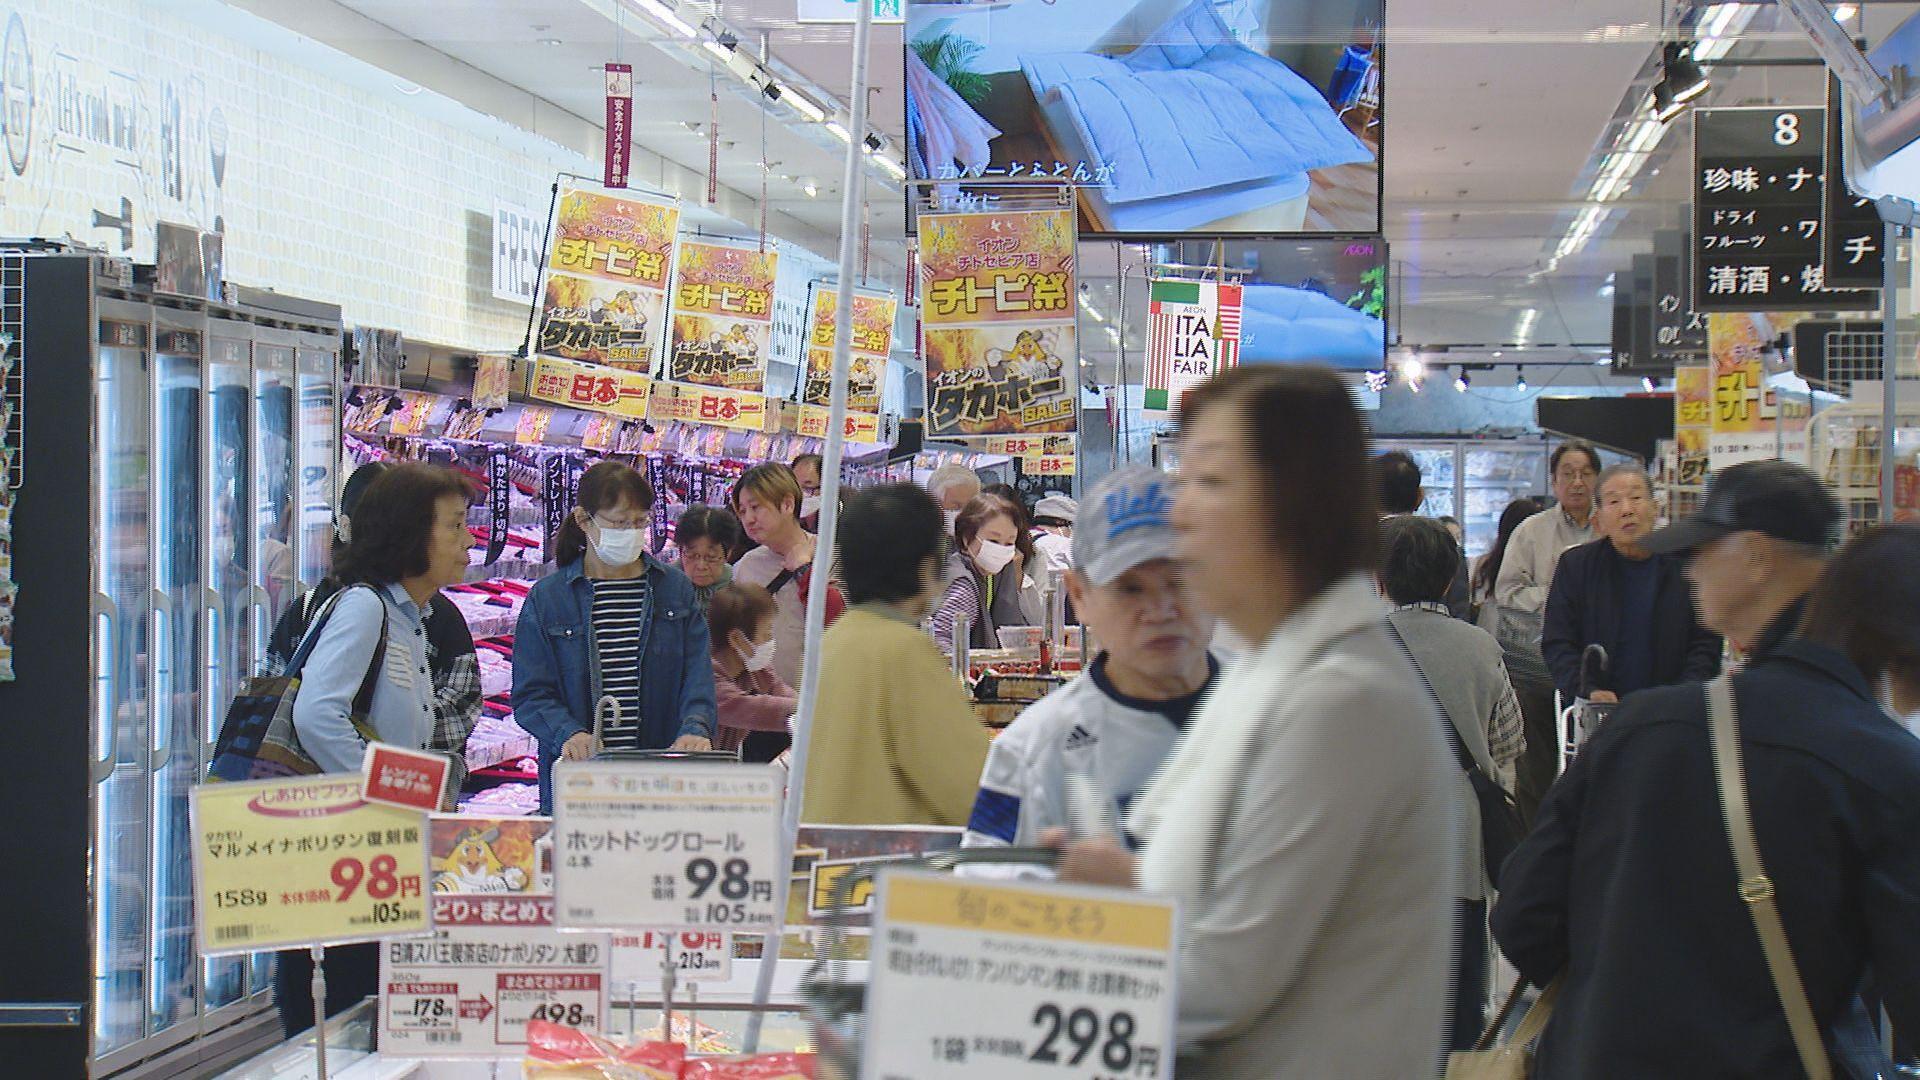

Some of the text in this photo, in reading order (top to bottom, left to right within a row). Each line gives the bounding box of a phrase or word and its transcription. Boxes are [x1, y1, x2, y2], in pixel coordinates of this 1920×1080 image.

[1774, 113, 1799, 145] 8
[936, 161, 1118, 182] カバーとふとんが
[1703, 167, 1824, 193] 珍味・ナ
[1713, 210, 1757, 225] ドライ
[979, 237, 1019, 252] イオン
[1703, 235, 1766, 250] フルーツ
[558, 237, 665, 281] チトピ祭
[681, 283, 768, 316] チトピ祭
[930, 271, 1068, 314] チトピ祭
[541, 318, 646, 351] タカホー
[815, 323, 889, 353] チピ祭
[1175, 314, 1210, 337] ITA
[1174, 336, 1209, 360] LIA
[673, 350, 757, 379] タカホー
[1173, 359, 1208, 376] FAIR
[570, 374, 645, 406] 日本一
[930, 375, 1066, 429] タカホー
[700, 395, 762, 421] 日本一
[566, 829, 745, 853] ホットドッグロール
[330, 853, 421, 904] 98円
[685, 857, 773, 902] 98円
[215, 889, 268, 908] 158g
[1027, 1002, 1160, 1076] 298円
